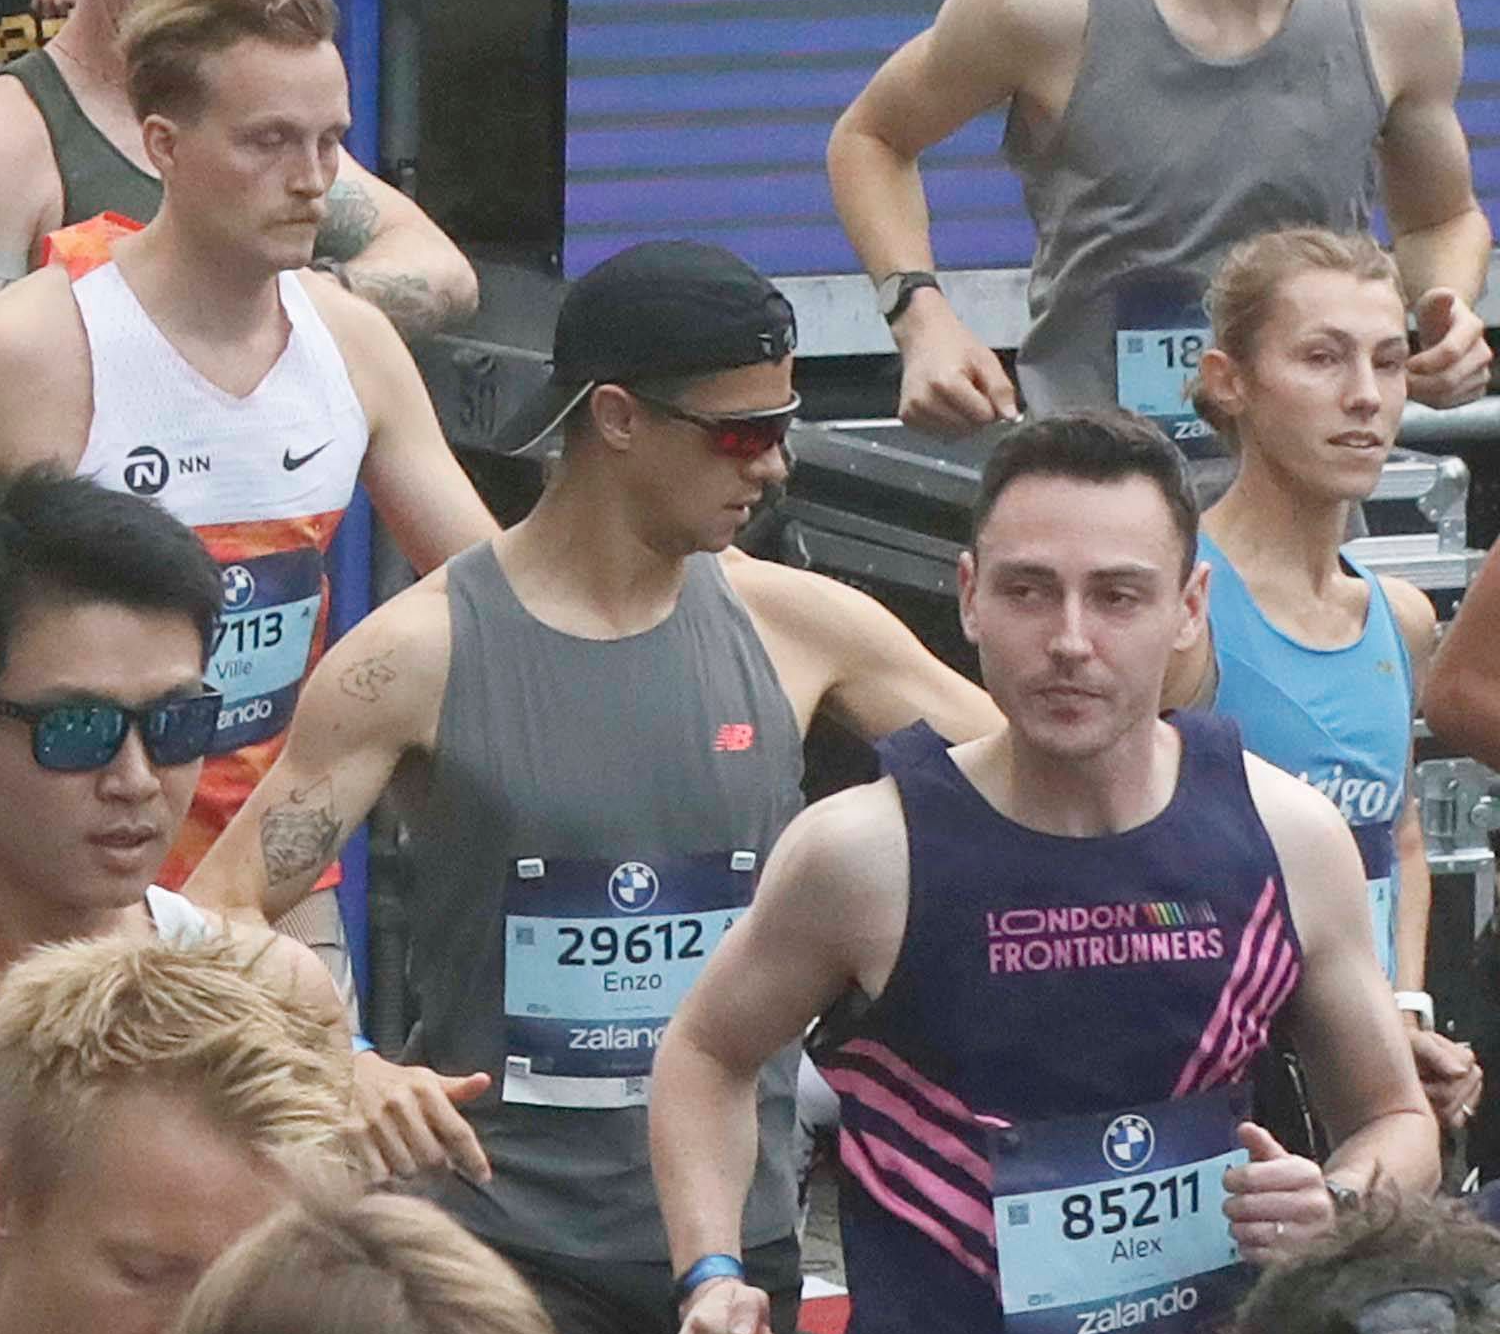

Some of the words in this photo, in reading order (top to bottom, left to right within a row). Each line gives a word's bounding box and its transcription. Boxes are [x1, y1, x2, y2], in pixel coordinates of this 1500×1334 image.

[985, 904, 1138, 937] LONDON
[556, 918, 704, 968] 29612
[987, 927, 1226, 975] FRONTRUNNERS
[601, 970, 664, 994] Enzo
[1060, 1170, 1203, 1244] 85211
[1110, 1230, 1164, 1263] Alex
